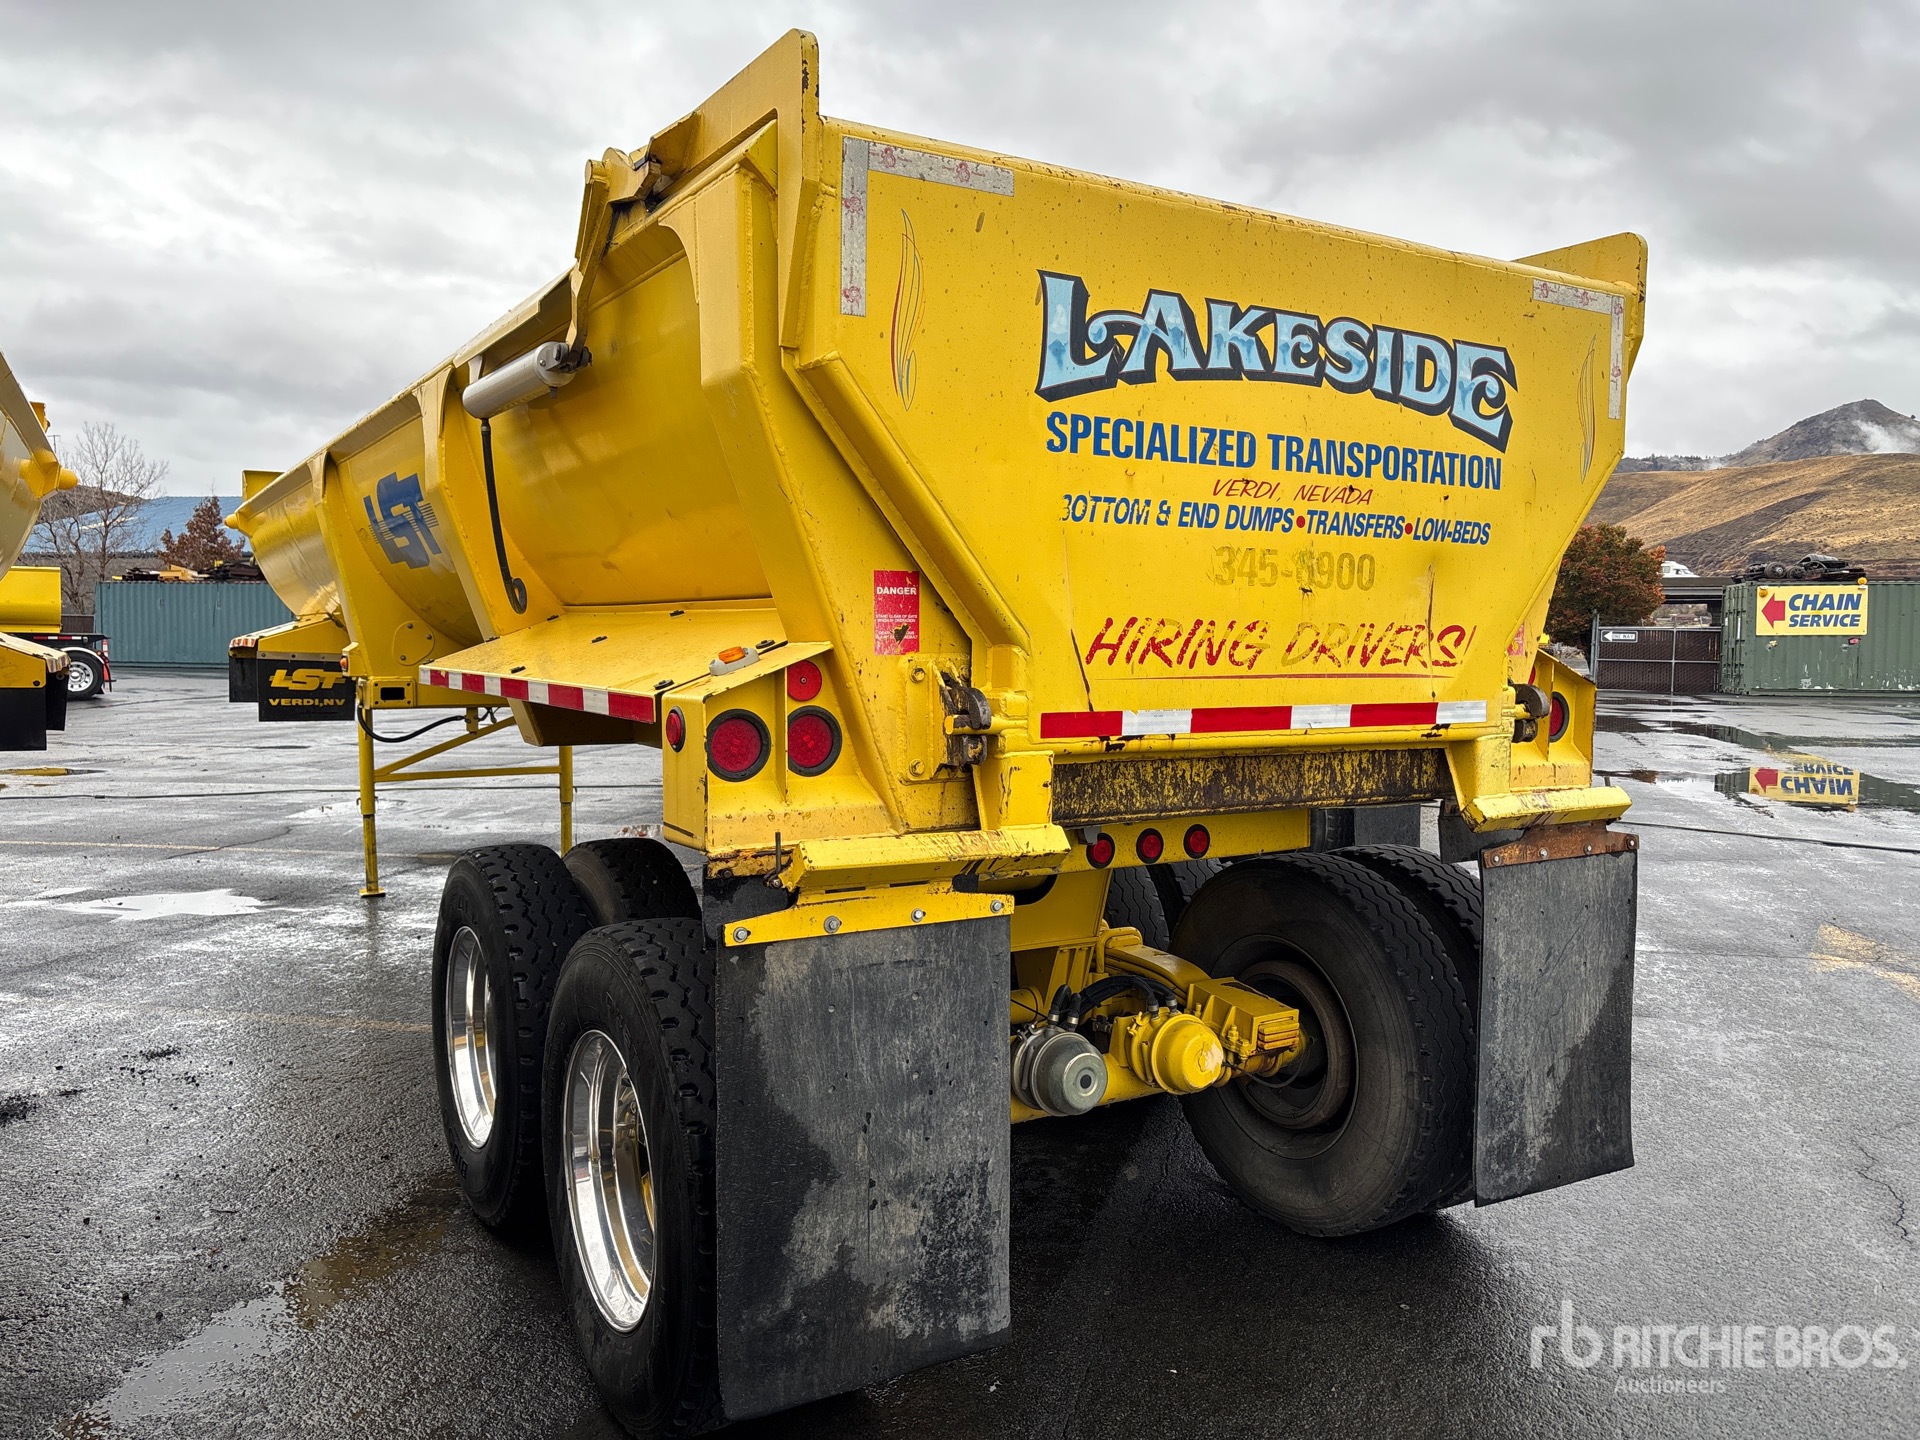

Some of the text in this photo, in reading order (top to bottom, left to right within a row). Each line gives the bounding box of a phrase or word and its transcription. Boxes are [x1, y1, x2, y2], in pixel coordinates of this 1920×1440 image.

[1035, 270, 1518, 453] LAKESIDE
[1046, 411, 1502, 490] SPECIALIZED TRANSPORTATION
[1212, 479, 1374, 505] VERDI, NEVADA
[1156, 499, 1171, 526] &
[1177, 501, 1220, 529] END
[1412, 517, 1492, 545] LOW-BEDS
[876, 586, 917, 595] DANGER
[1788, 593, 1862, 611] CHAIN
[1788, 614, 1862, 628] SERVICE
[1085, 616, 1270, 670] HIRING
[270, 668, 346, 690] LST
